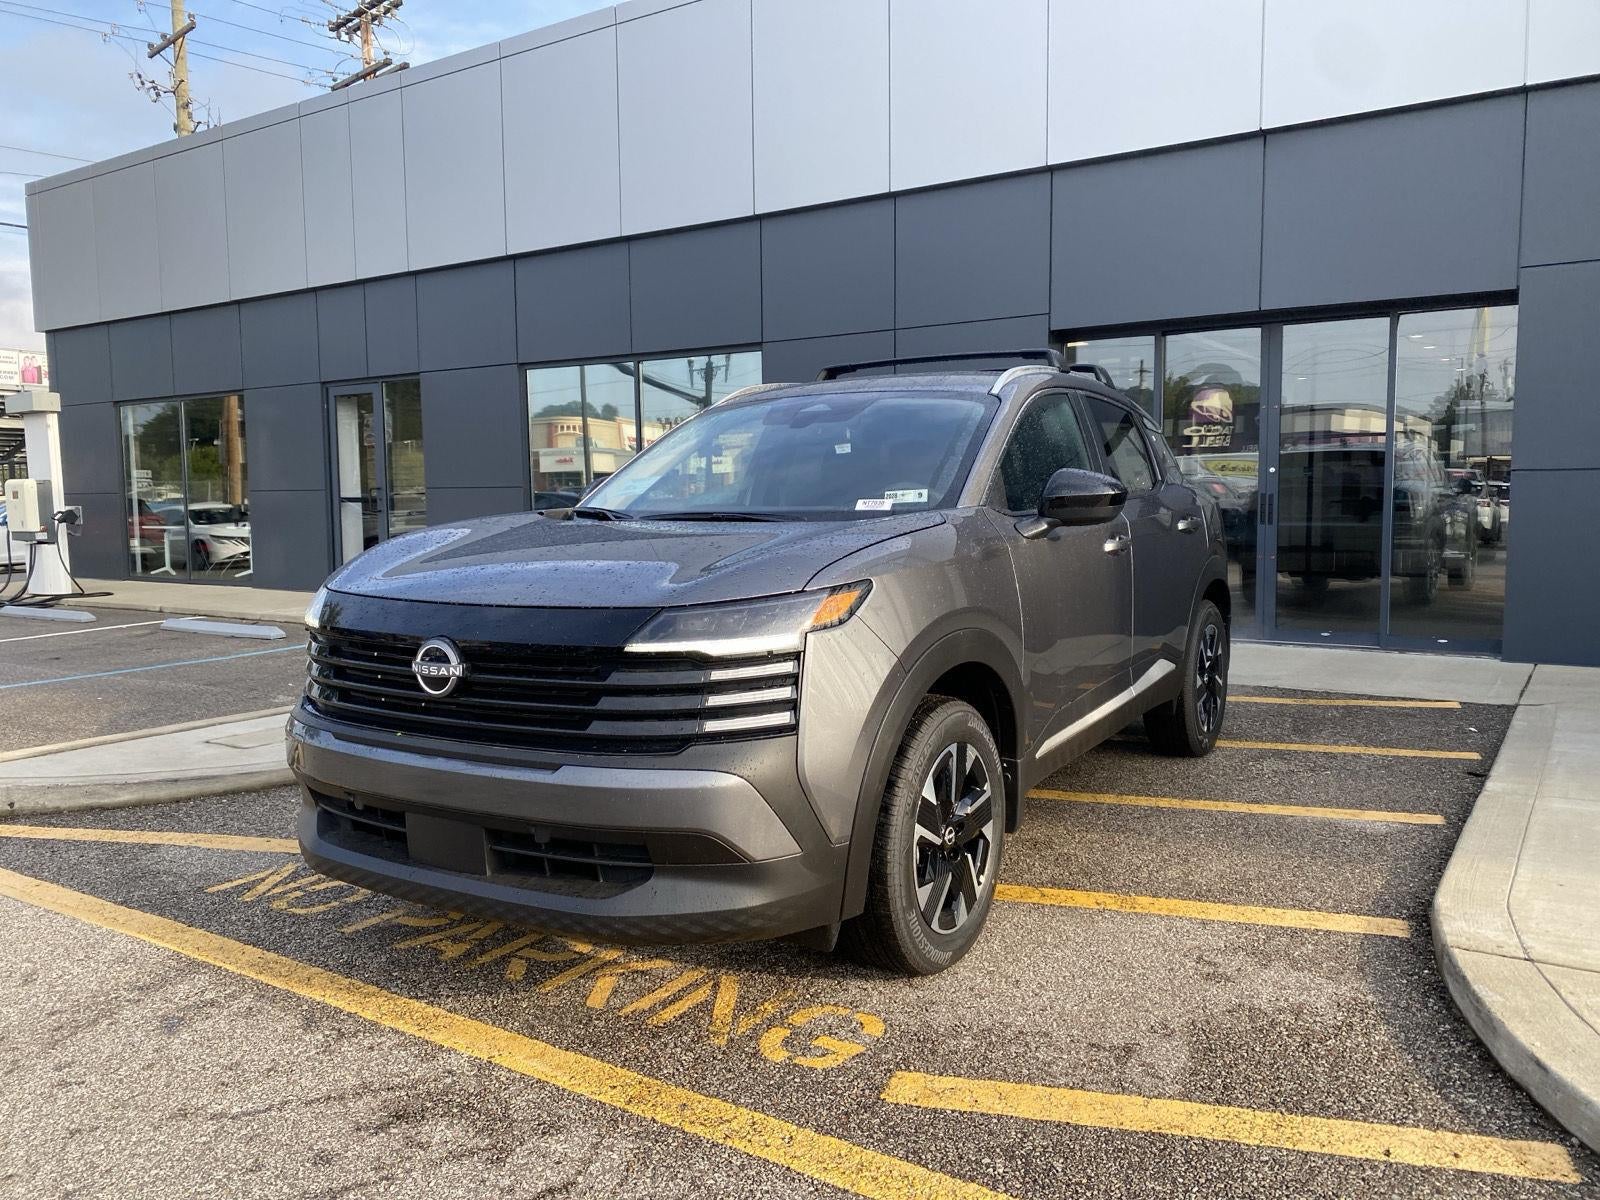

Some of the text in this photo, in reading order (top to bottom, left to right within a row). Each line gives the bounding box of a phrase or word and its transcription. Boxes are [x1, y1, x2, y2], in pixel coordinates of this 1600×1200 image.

[412, 662, 461, 676] NISSAN
[202, 861, 886, 1070] NO PARKING
[906, 908, 953, 966] BRIDGESTONE
